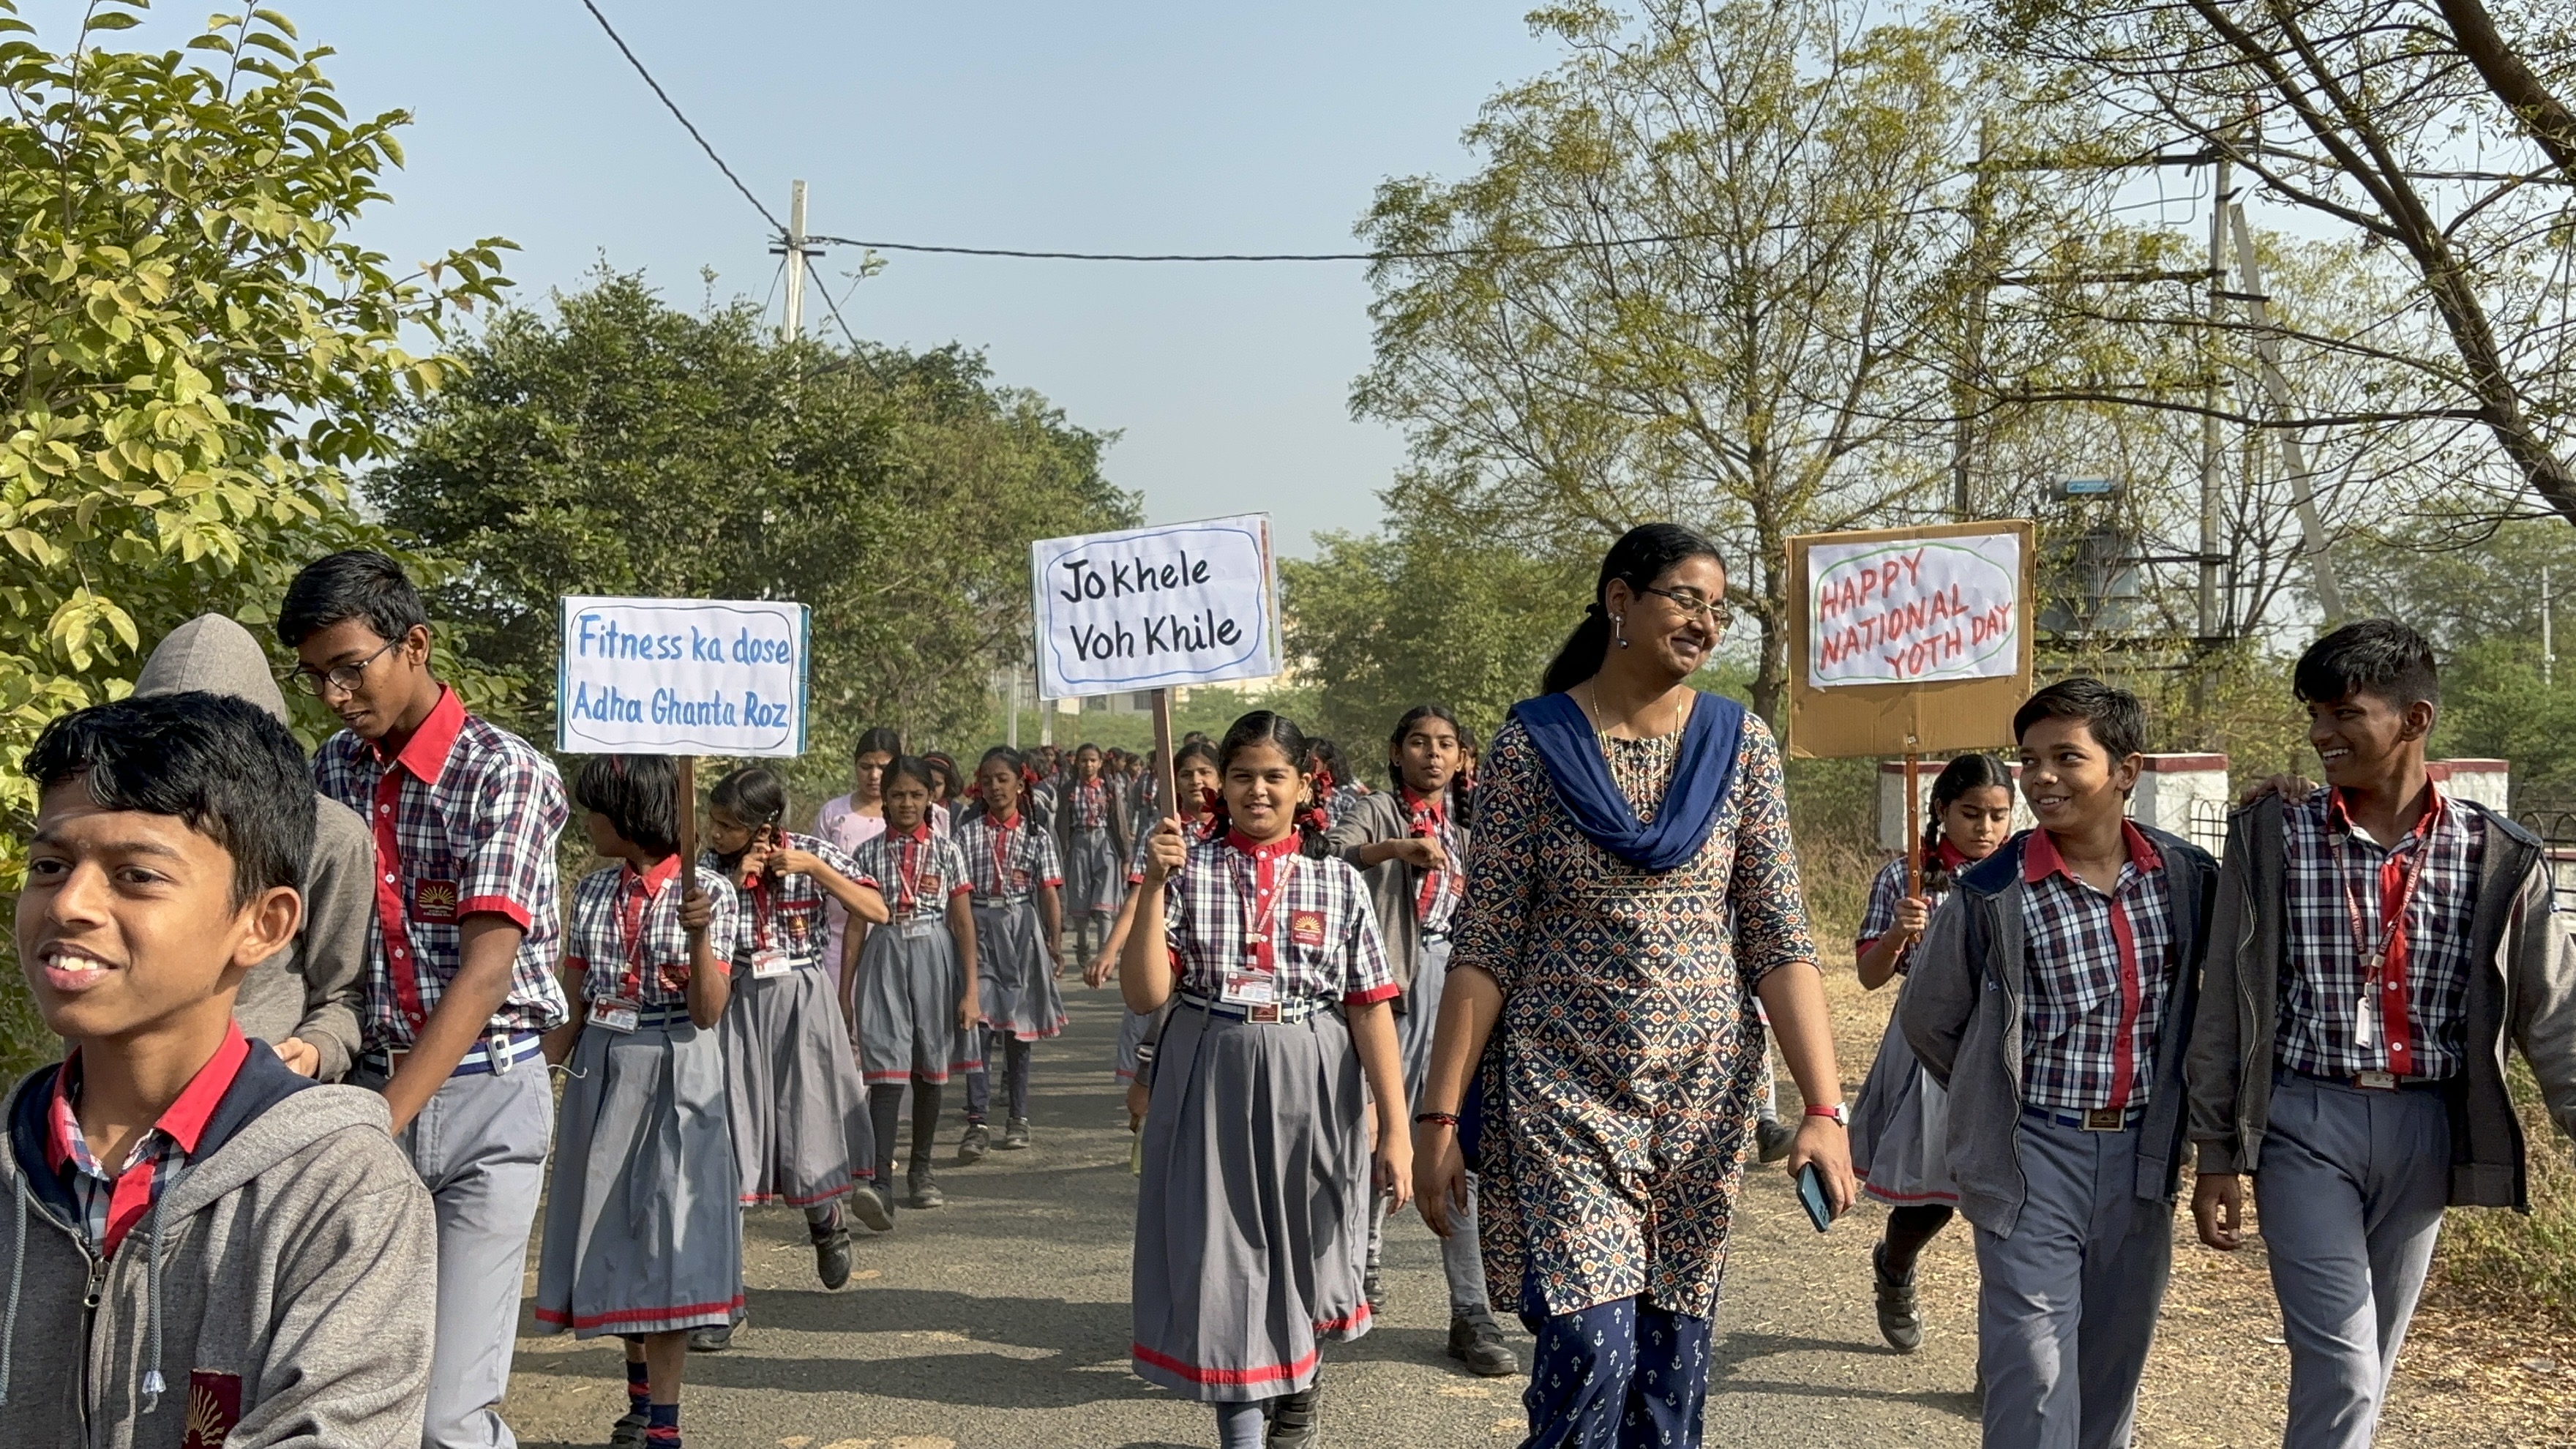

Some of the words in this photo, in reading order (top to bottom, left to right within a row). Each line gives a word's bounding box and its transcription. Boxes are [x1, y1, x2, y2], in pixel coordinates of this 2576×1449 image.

[1819, 547, 1925, 622] HAPPY
[579, 614, 682, 662] Fitness
[691, 626, 725, 664] ka
[733, 626, 790, 665] dose
[1070, 620, 1134, 661] Voh
[1144, 609, 1242, 655] Khile
[1819, 583, 1969, 670] NATIONAL
[1884, 626, 1961, 679] YOTH
[1972, 602, 2012, 646] DAY
[572, 681, 644, 723] Adha
[651, 687, 737, 727] Ghanta
[743, 691, 788, 728] Roz
